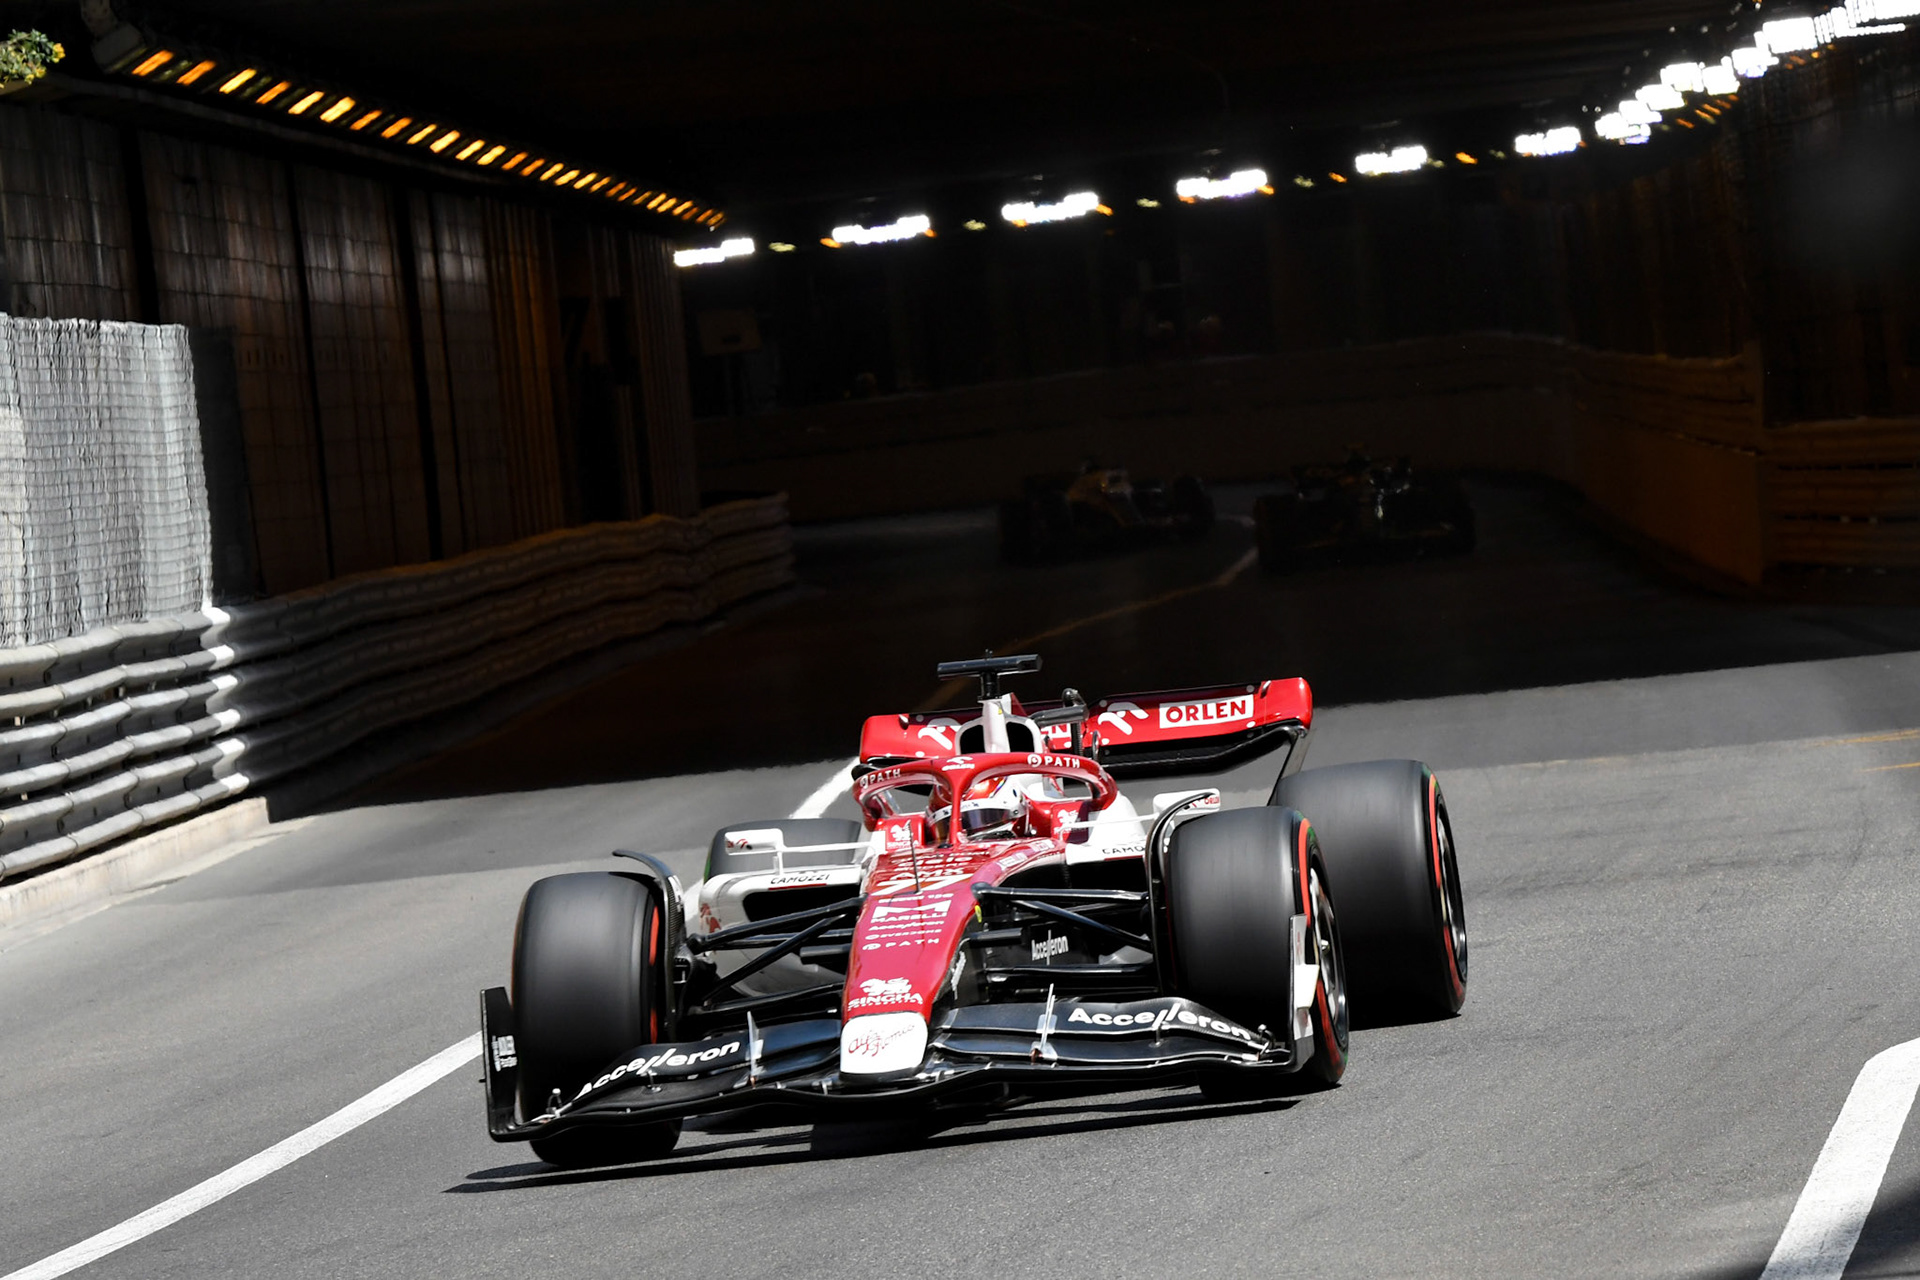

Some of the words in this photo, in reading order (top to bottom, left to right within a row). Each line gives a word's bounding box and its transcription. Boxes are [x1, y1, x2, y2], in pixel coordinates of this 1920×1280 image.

[1166, 700, 1246, 723] ORLEN
[1044, 755, 1081, 769] PATH
[869, 768, 901, 784] PATH
[770, 873, 830, 885] CAMOZZI
[870, 873, 974, 896] 77
[870, 912, 948, 924] MARELLI
[885, 938, 940, 948] PATH
[848, 992, 924, 1008] SINGHA
